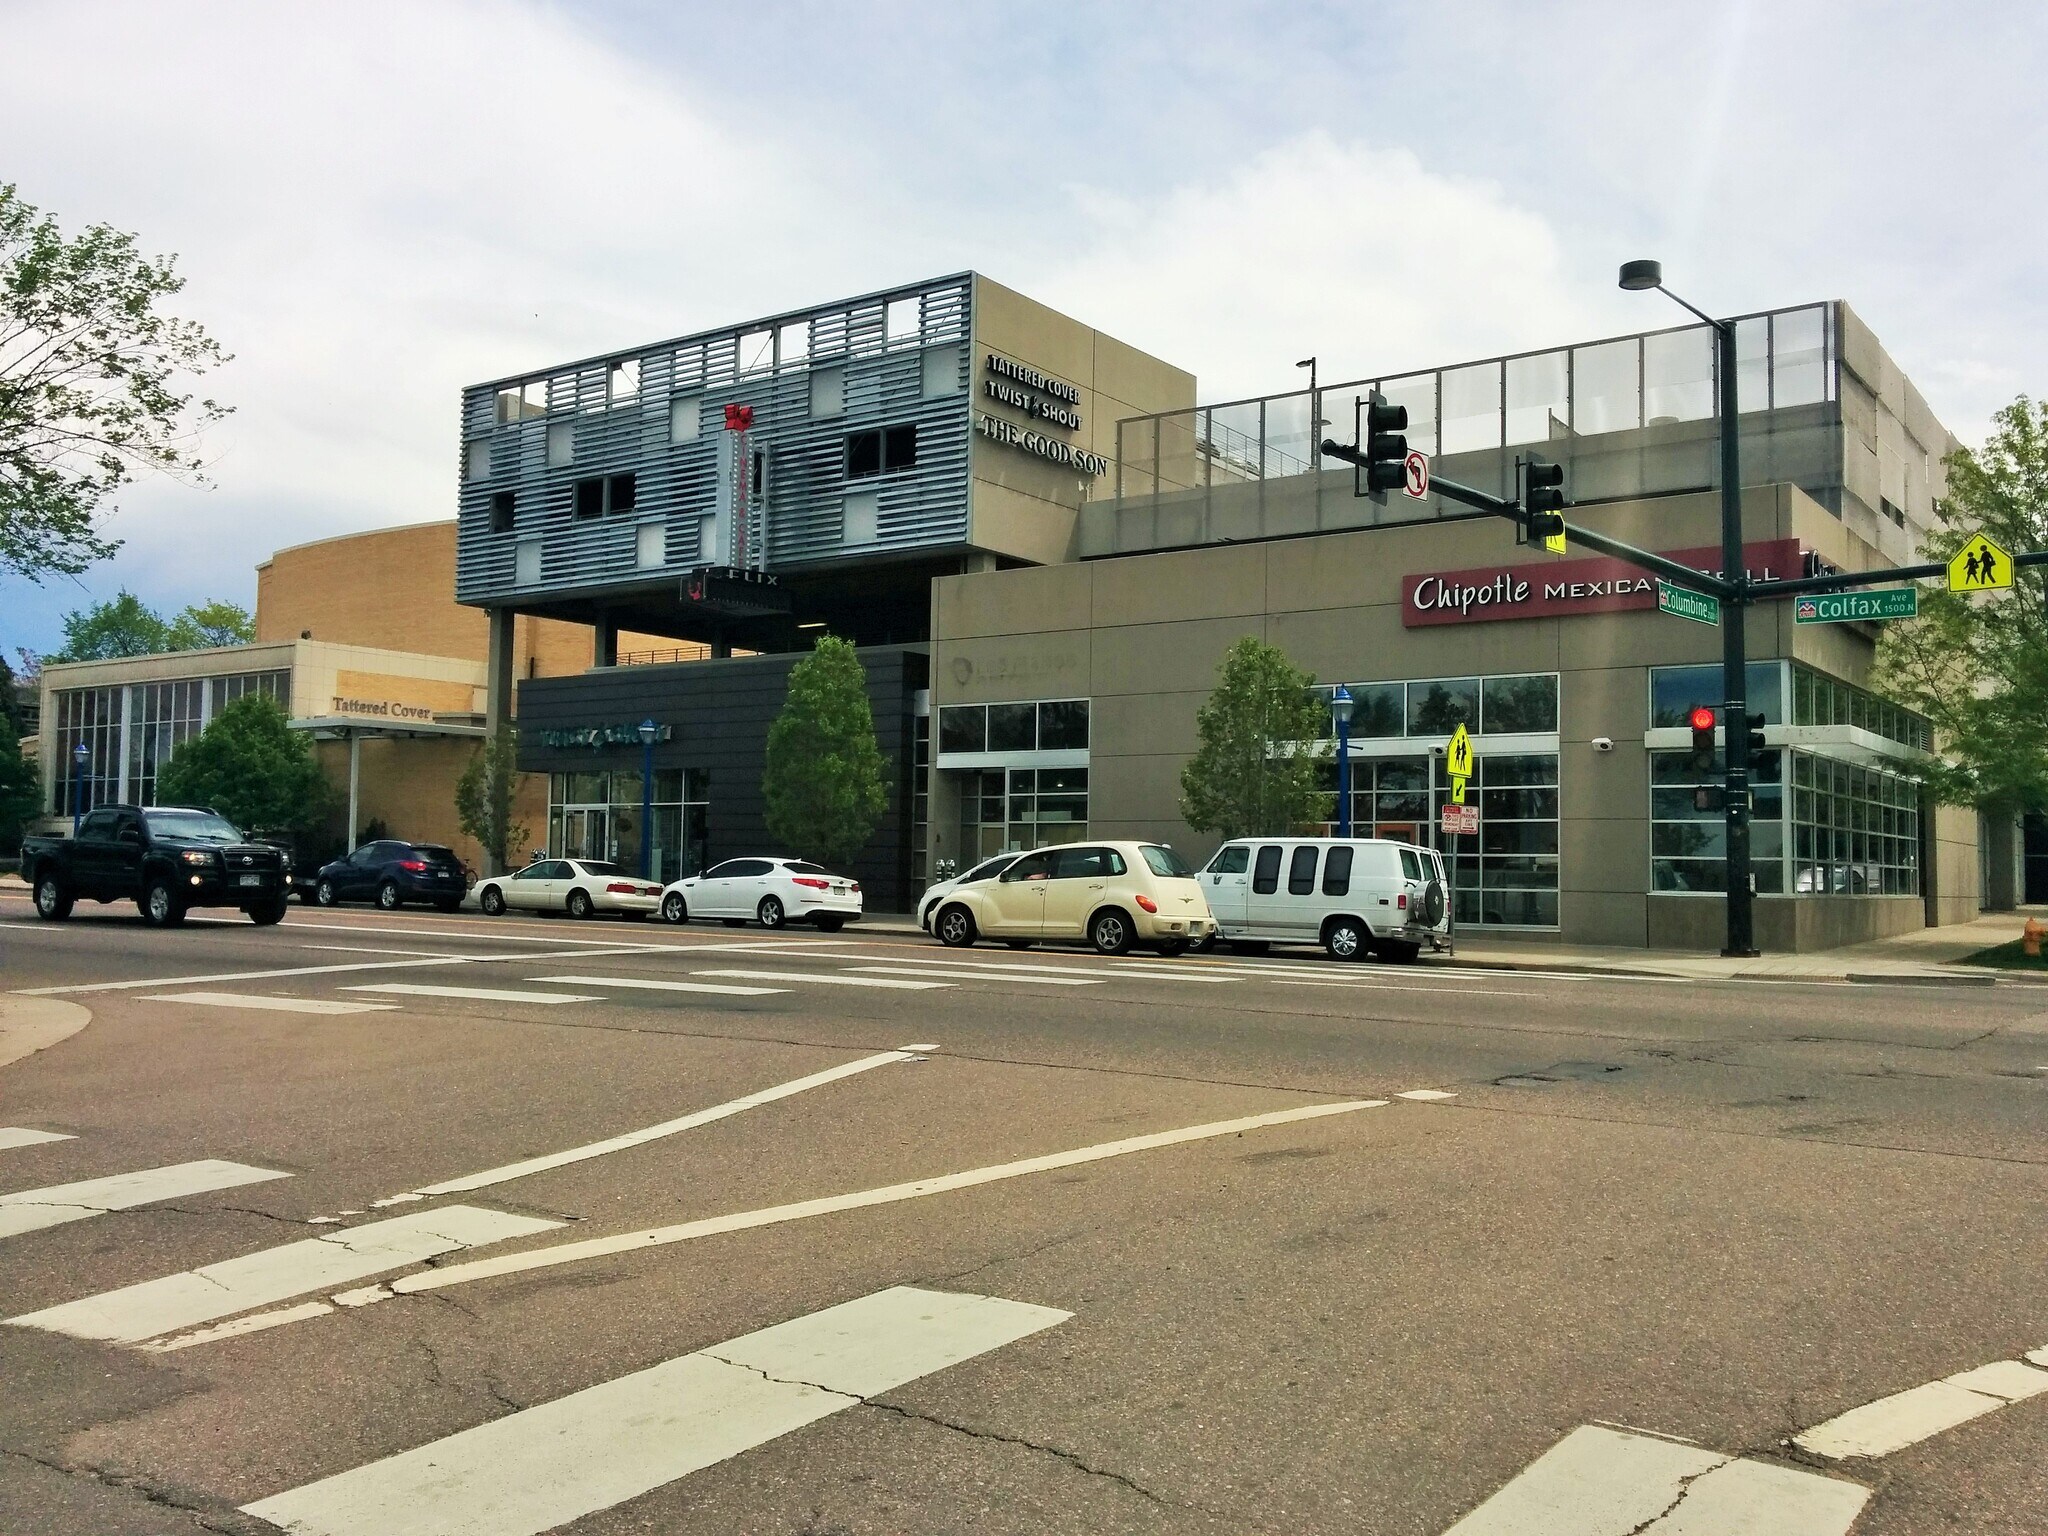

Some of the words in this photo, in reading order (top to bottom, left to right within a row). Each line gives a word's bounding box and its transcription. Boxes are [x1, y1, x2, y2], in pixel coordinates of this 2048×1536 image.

[988, 355, 1044, 389] TATTERED
[1047, 379, 1081, 404] COVER
[987, 381, 1029, 409] TWIST
[1042, 402, 1082, 430] SHOUT
[981, 415, 1019, 446] THE
[1021, 431, 1071, 463] GOOD
[1072, 447, 1107, 477] SON
[739, 434, 748, 502] CINEMA
[1413, 573, 1529, 615] Chipotle
[1544, 577, 1672, 600] MEXICA
[1667, 590, 1708, 618] Columbine
[1818, 597, 1882, 618] Colfax
[1890, 594, 1907, 602] Ave
[1884, 603, 1905, 613] 1500
[1907, 603, 1915, 611] N
[333, 697, 388, 715] Tattered
[391, 703, 431, 719] Cover
